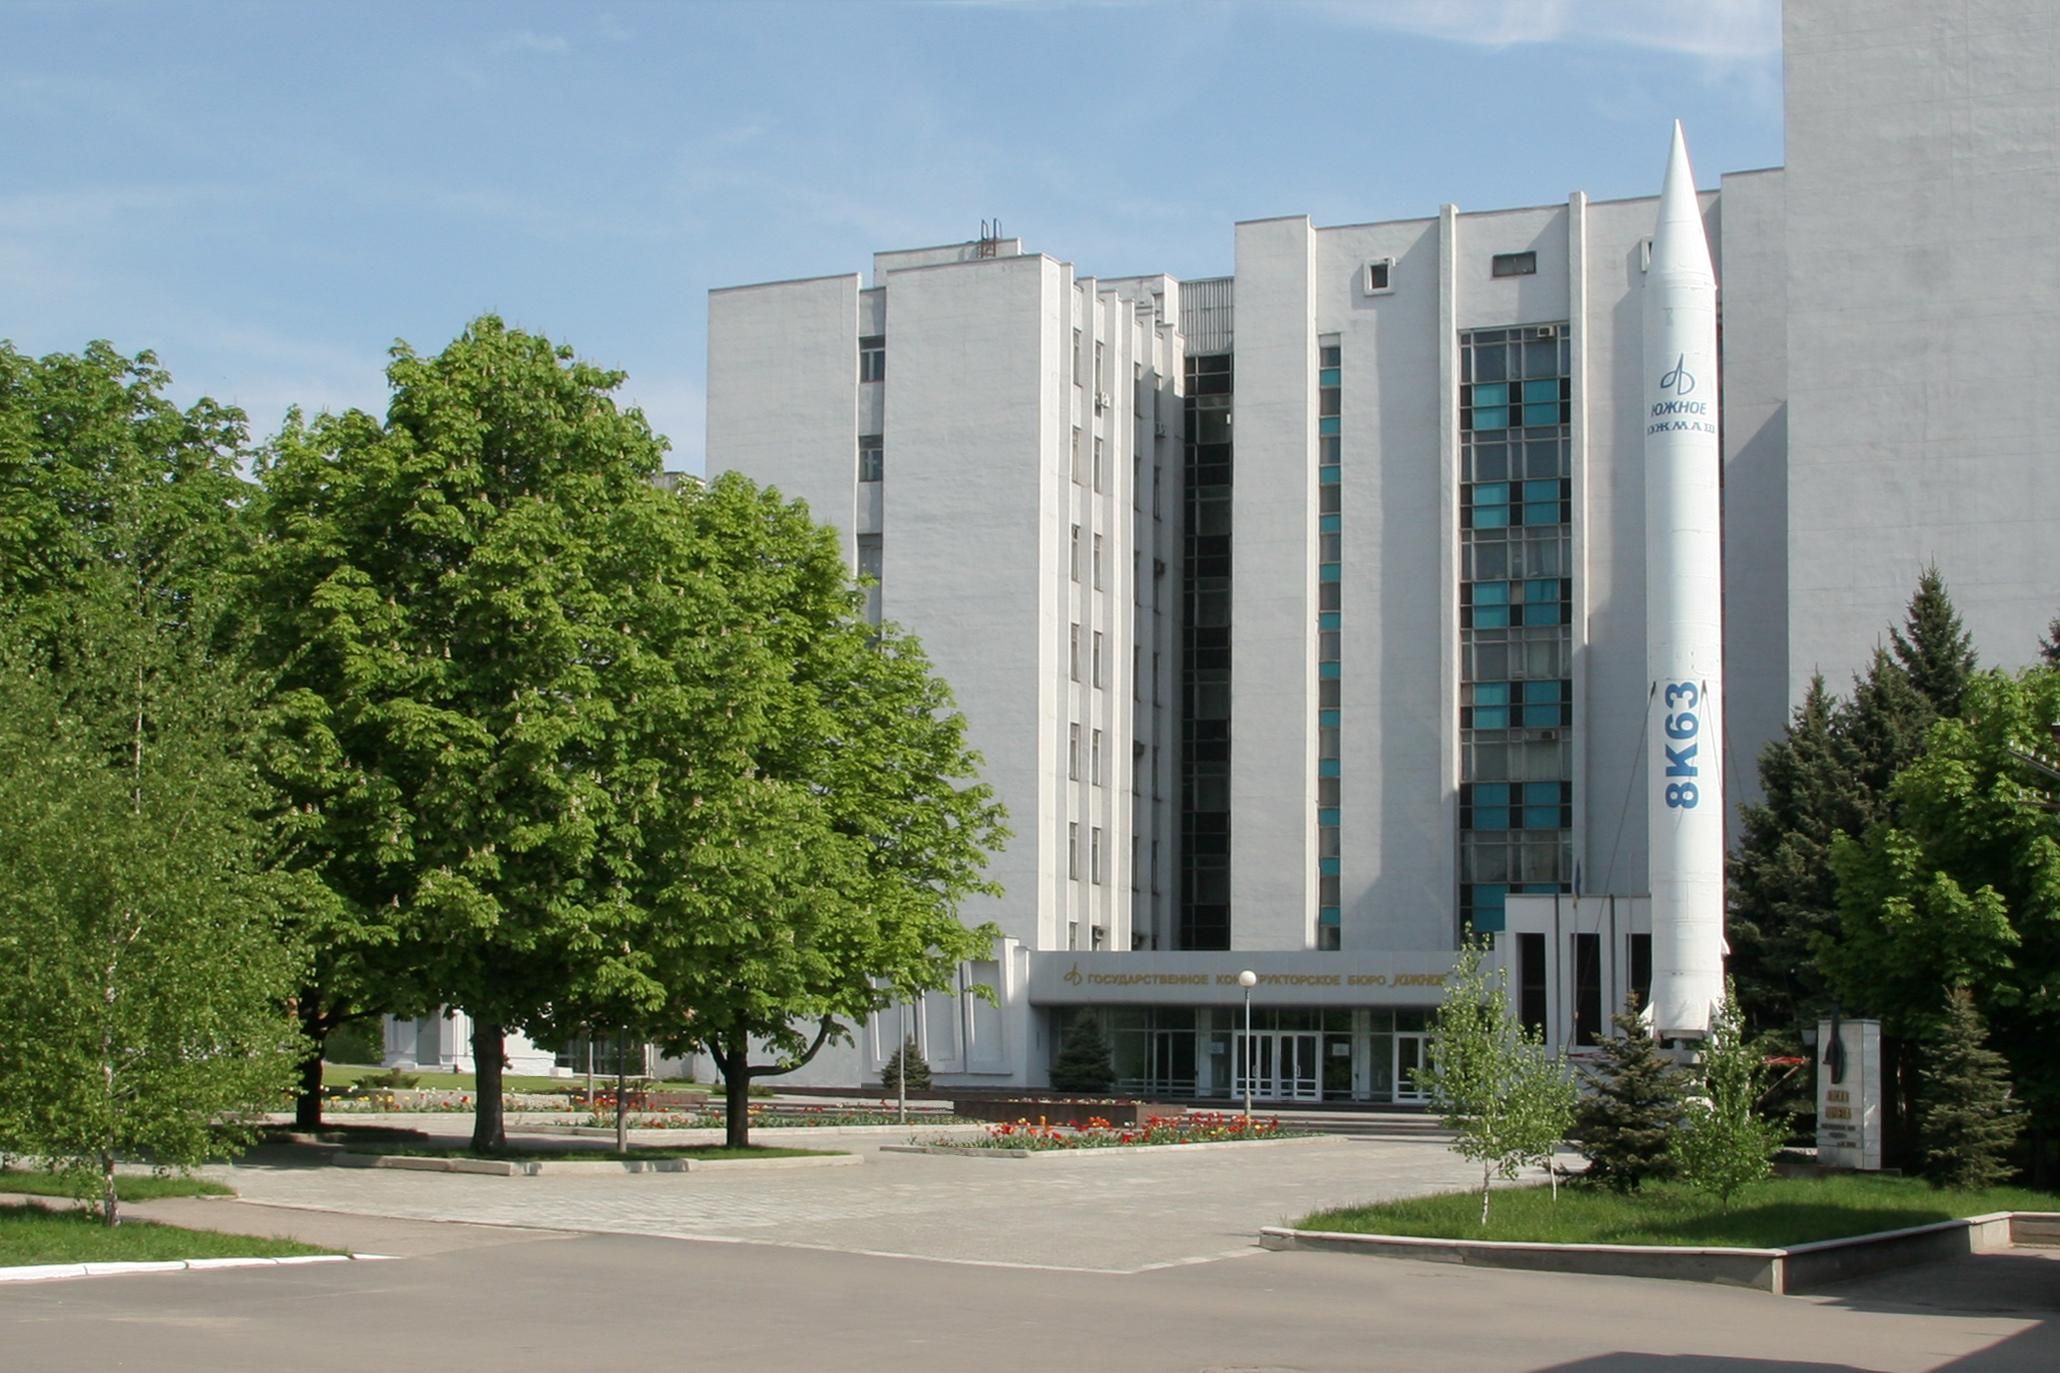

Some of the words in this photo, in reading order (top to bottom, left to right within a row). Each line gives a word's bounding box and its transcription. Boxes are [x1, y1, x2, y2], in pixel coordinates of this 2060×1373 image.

[1650, 400, 1707, 418] ЮЖНОЕ
[1087, 973, 1209, 986] ГОСУДАРСТВЕННОЕ
[1216, 974, 1341, 986] КОНРУКТОРСКОЕ
[1347, 974, 1386, 986] БЮРО
